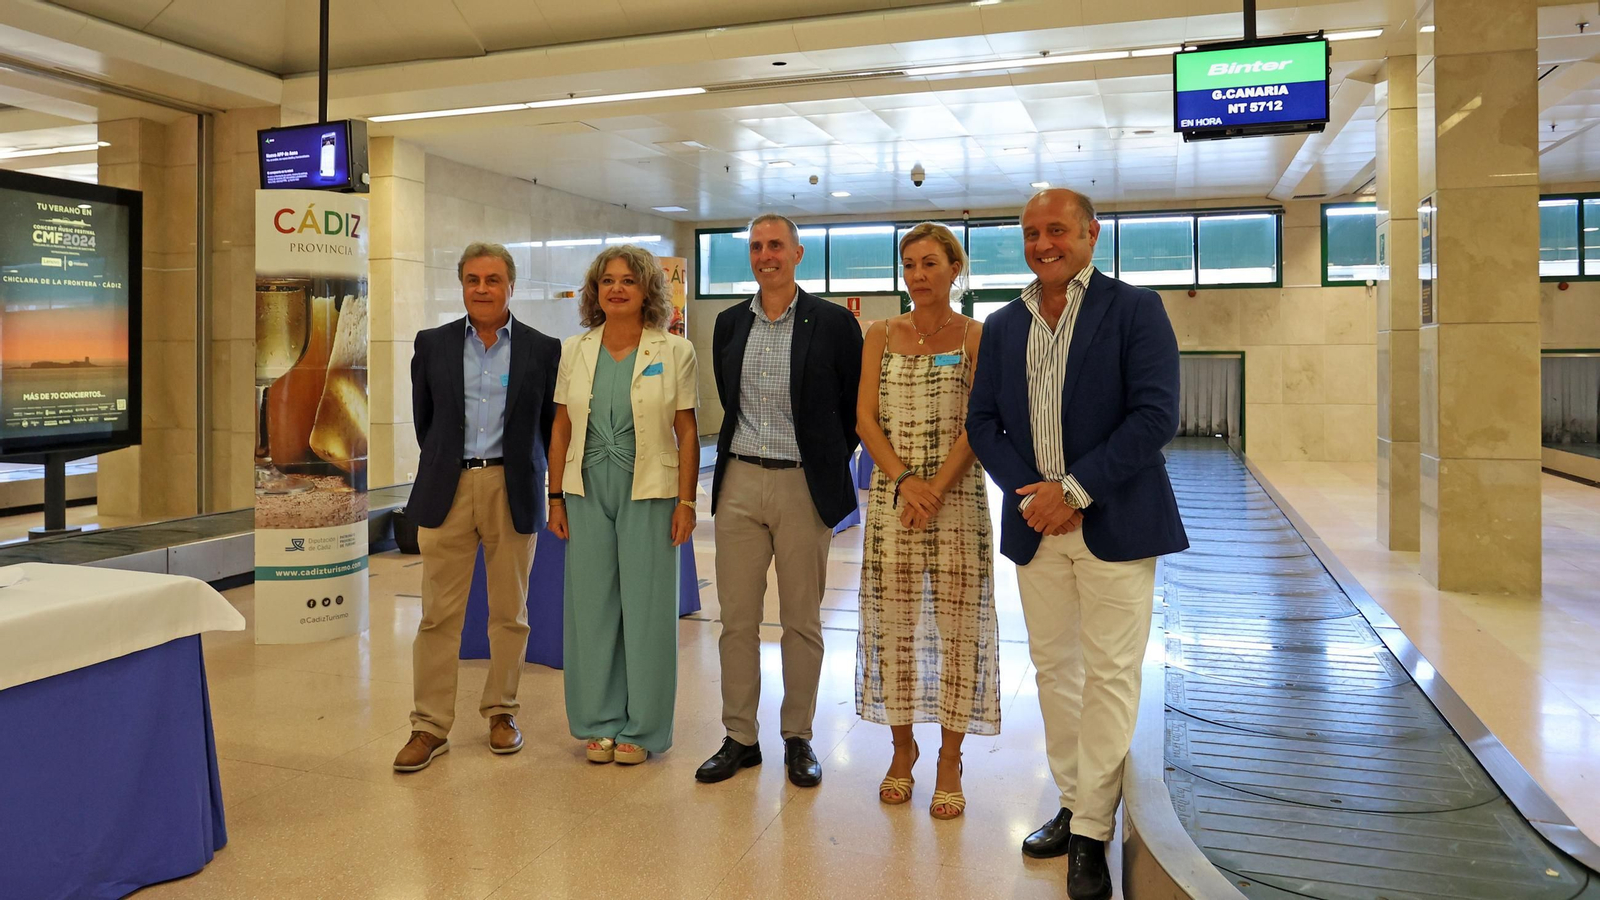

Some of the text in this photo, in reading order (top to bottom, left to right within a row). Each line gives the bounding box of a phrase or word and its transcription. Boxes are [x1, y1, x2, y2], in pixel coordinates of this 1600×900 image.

[1207, 60, 1293, 76] Binter
[1211, 84, 1289, 101] G.CANARIA
[1227, 100, 1284, 115] NT 5712
[1180, 117, 1223, 128] EN HORA
[36, 203, 92, 216] TU VERANO EN
[273, 203, 361, 239] CÁDIZ
[32, 230, 96, 247] CMF2024
[290, 243, 353, 256] PROVINCIA
[2, 275, 39, 285] CHICLANA
[63, 279, 98, 288] FRONTERA
[102, 281, 122, 289] CÁDIZ
[23, 391, 40, 401] MÁS
[40, 392, 50, 400] DE
[50, 392, 59, 400] 70
[308, 536, 336, 545] Diputación
[275, 561, 362, 577] www.cadizturismo.com
[299, 612, 349, 625] @CadizTurismo
